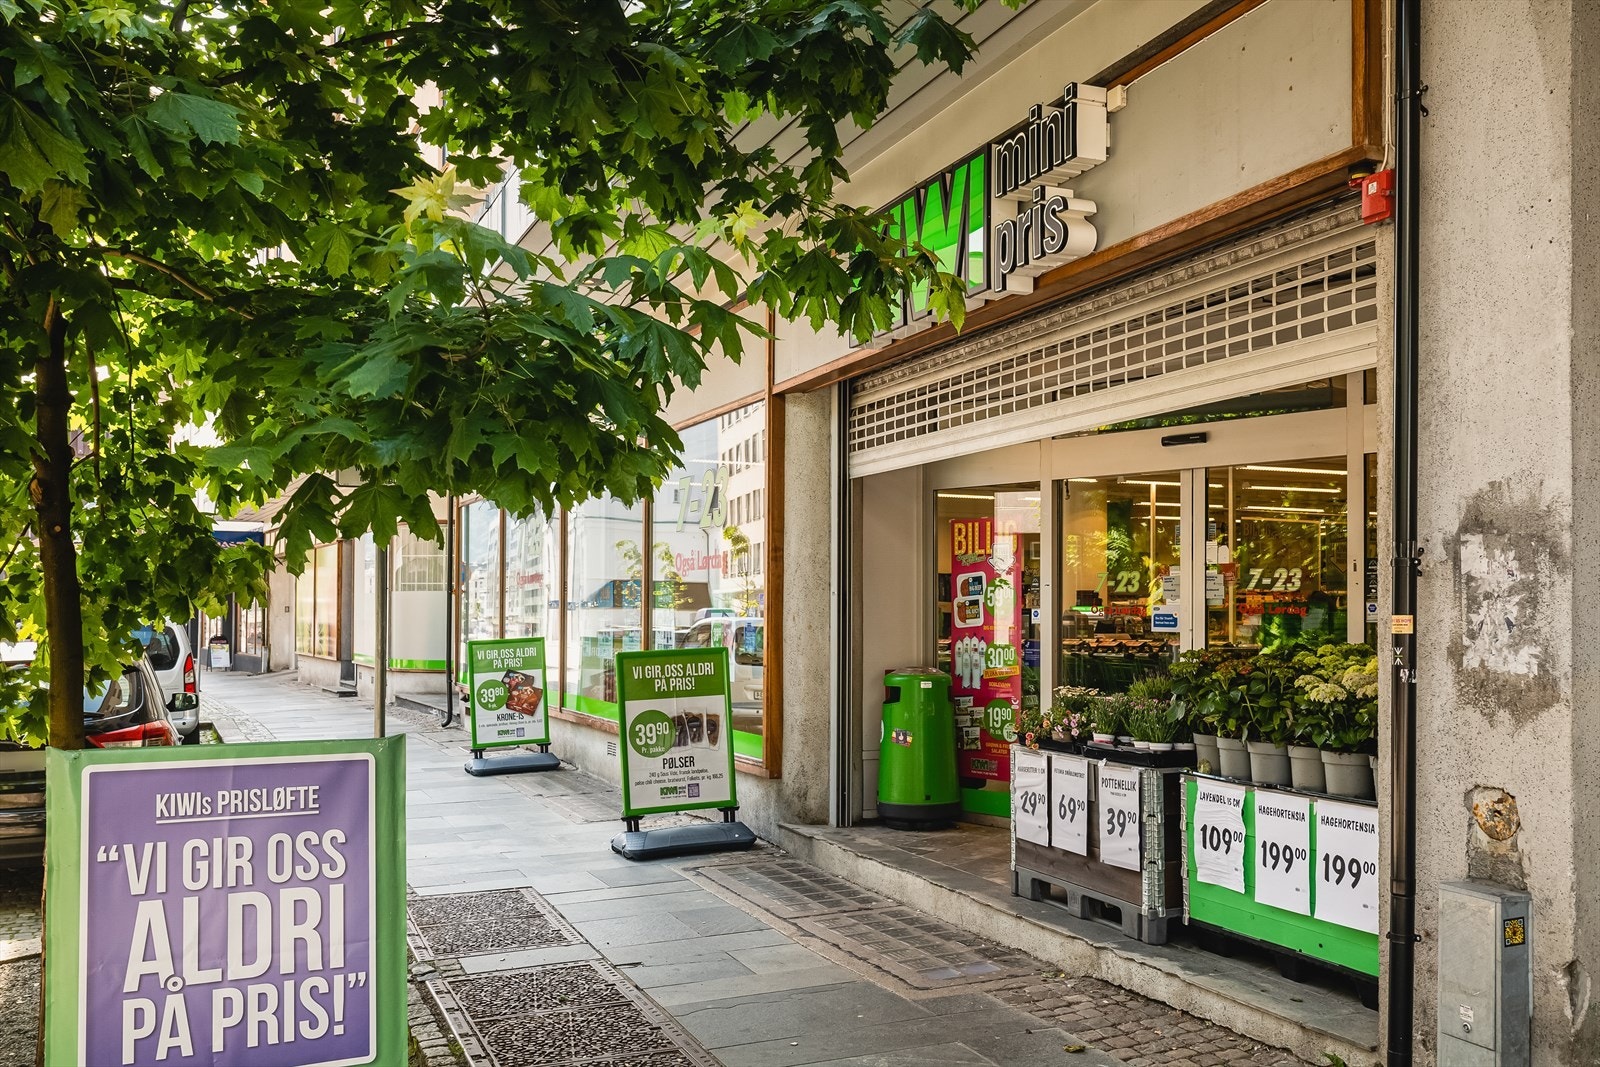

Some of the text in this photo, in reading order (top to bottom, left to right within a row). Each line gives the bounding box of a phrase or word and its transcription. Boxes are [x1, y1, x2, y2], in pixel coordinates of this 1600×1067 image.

[995, 82, 1077, 198] mini
[849, 146, 989, 348] IWI
[994, 185, 1068, 293] pris
[675, 549, 695, 577] Også
[1093, 570, 1141, 593] 7-23
[1246, 567, 1303, 592] 7-23
[1239, 602, 1307, 617] Også Lørdag
[477, 647, 537, 660] VI GIR OSS ALDRI
[493, 657, 523, 669] PÅ PRIS!
[632, 662, 714, 680] VI GIR OSS ALDRI
[654, 675, 695, 692] PÅ PRIS!
[649, 745, 665, 754] pakke
[662, 756, 695, 770] PØLSER
[155, 785, 320, 818] KIWIs PRISLØFTE
[1199, 792, 1226, 805] LAVENDEL
[1232, 798, 1241, 808] CM
[1258, 805, 1306, 822] HAGEHORTENSIA
[1321, 815, 1376, 834] HAGEHORTENSIA
[182, 835, 254, 891] GIR
[266, 828, 347, 884] OSS
[123, 883, 346, 993] ALDRI
[122, 975, 195, 1066] PÅ
